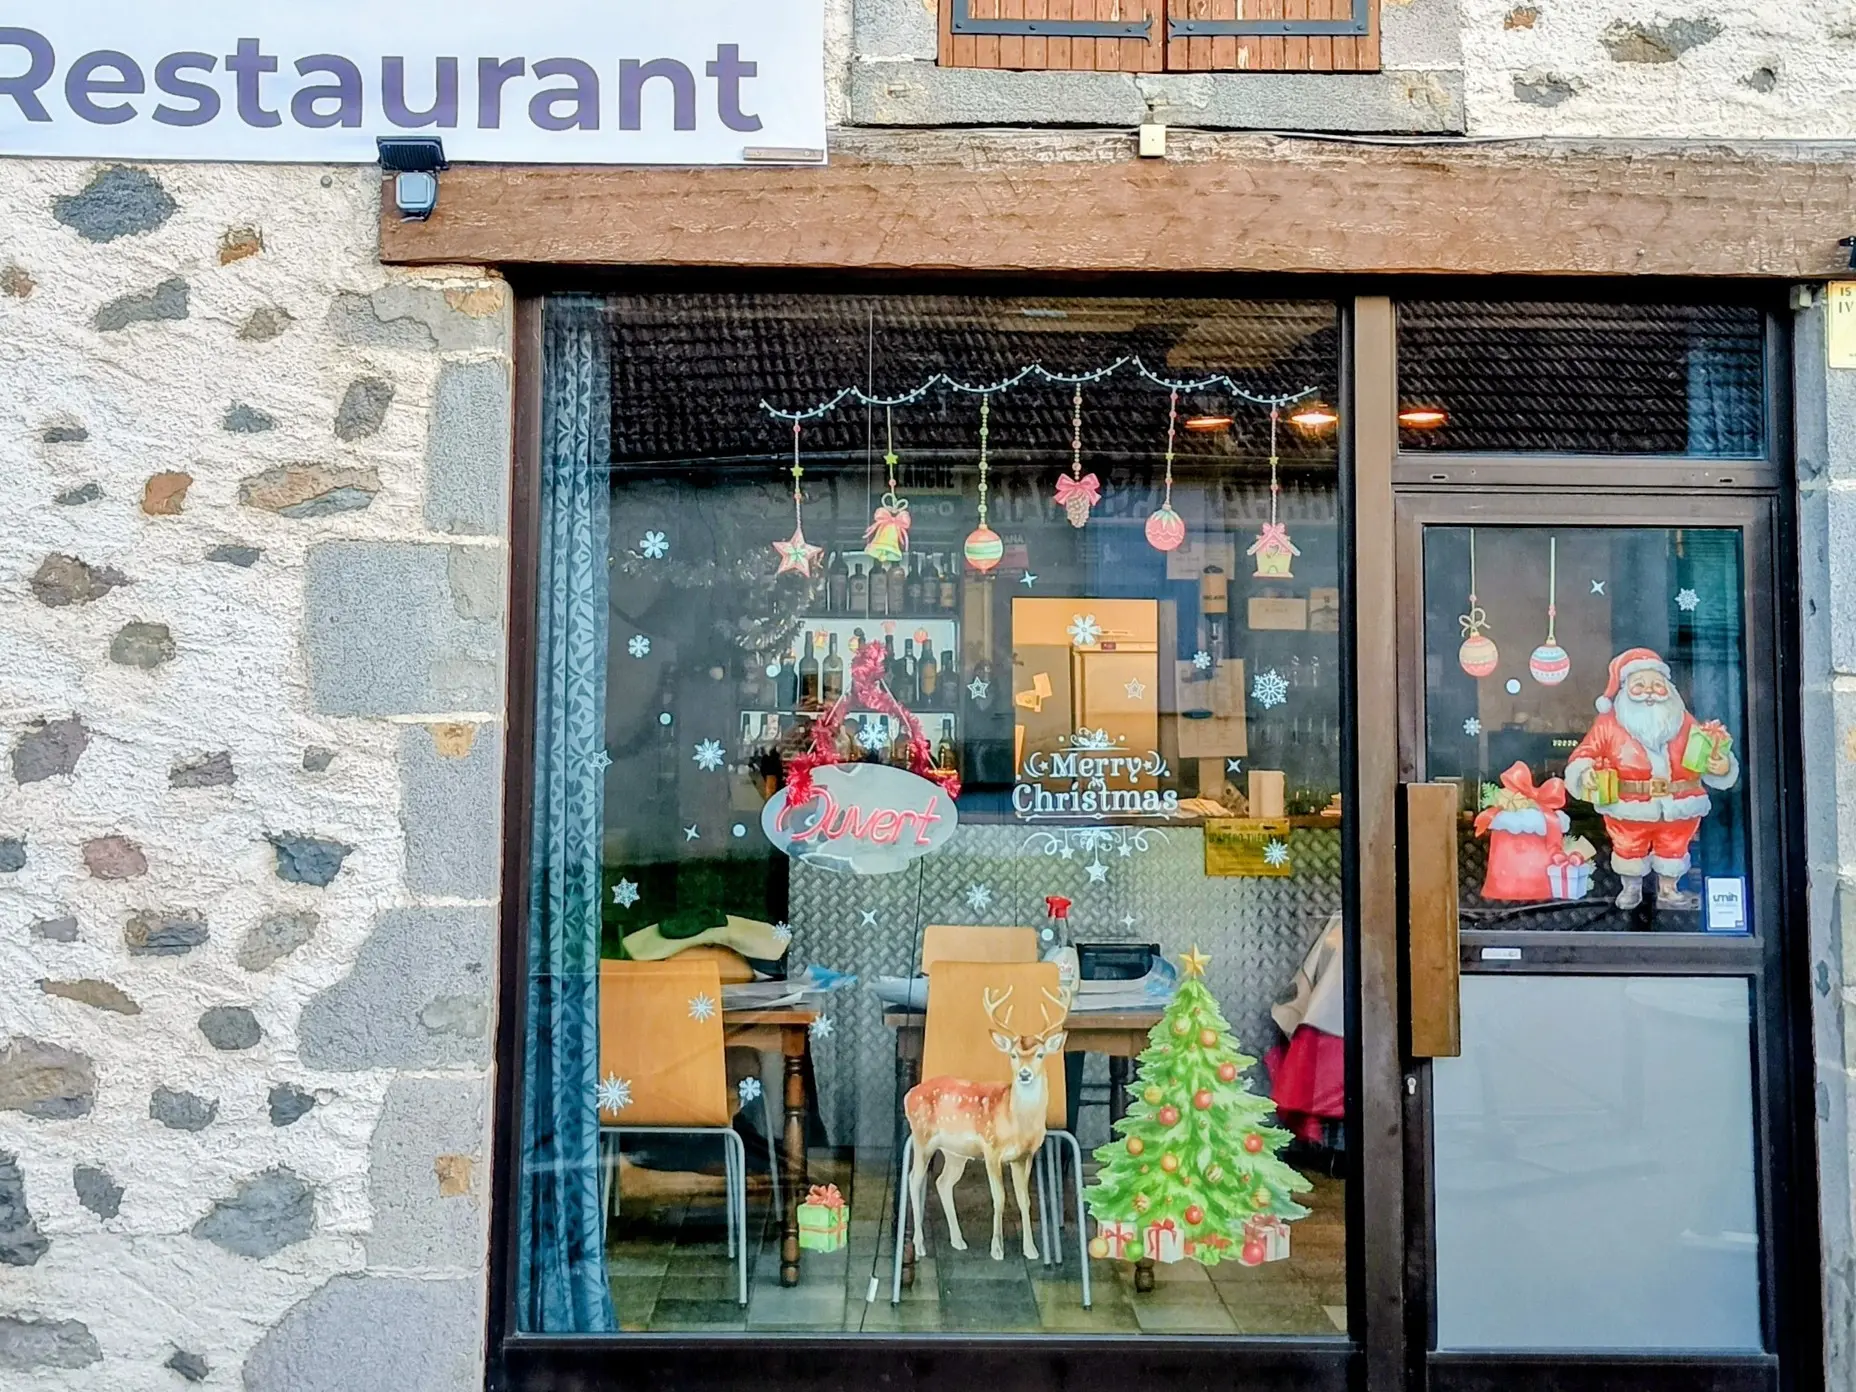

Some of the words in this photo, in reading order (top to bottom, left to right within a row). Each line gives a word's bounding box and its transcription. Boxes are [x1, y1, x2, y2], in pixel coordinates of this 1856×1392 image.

[0, 26, 764, 133] Restaurant
[1050, 753, 1142, 783] Merry
[776, 784, 942, 845] Ouvert
[1012, 779, 1178, 812] Christmas
